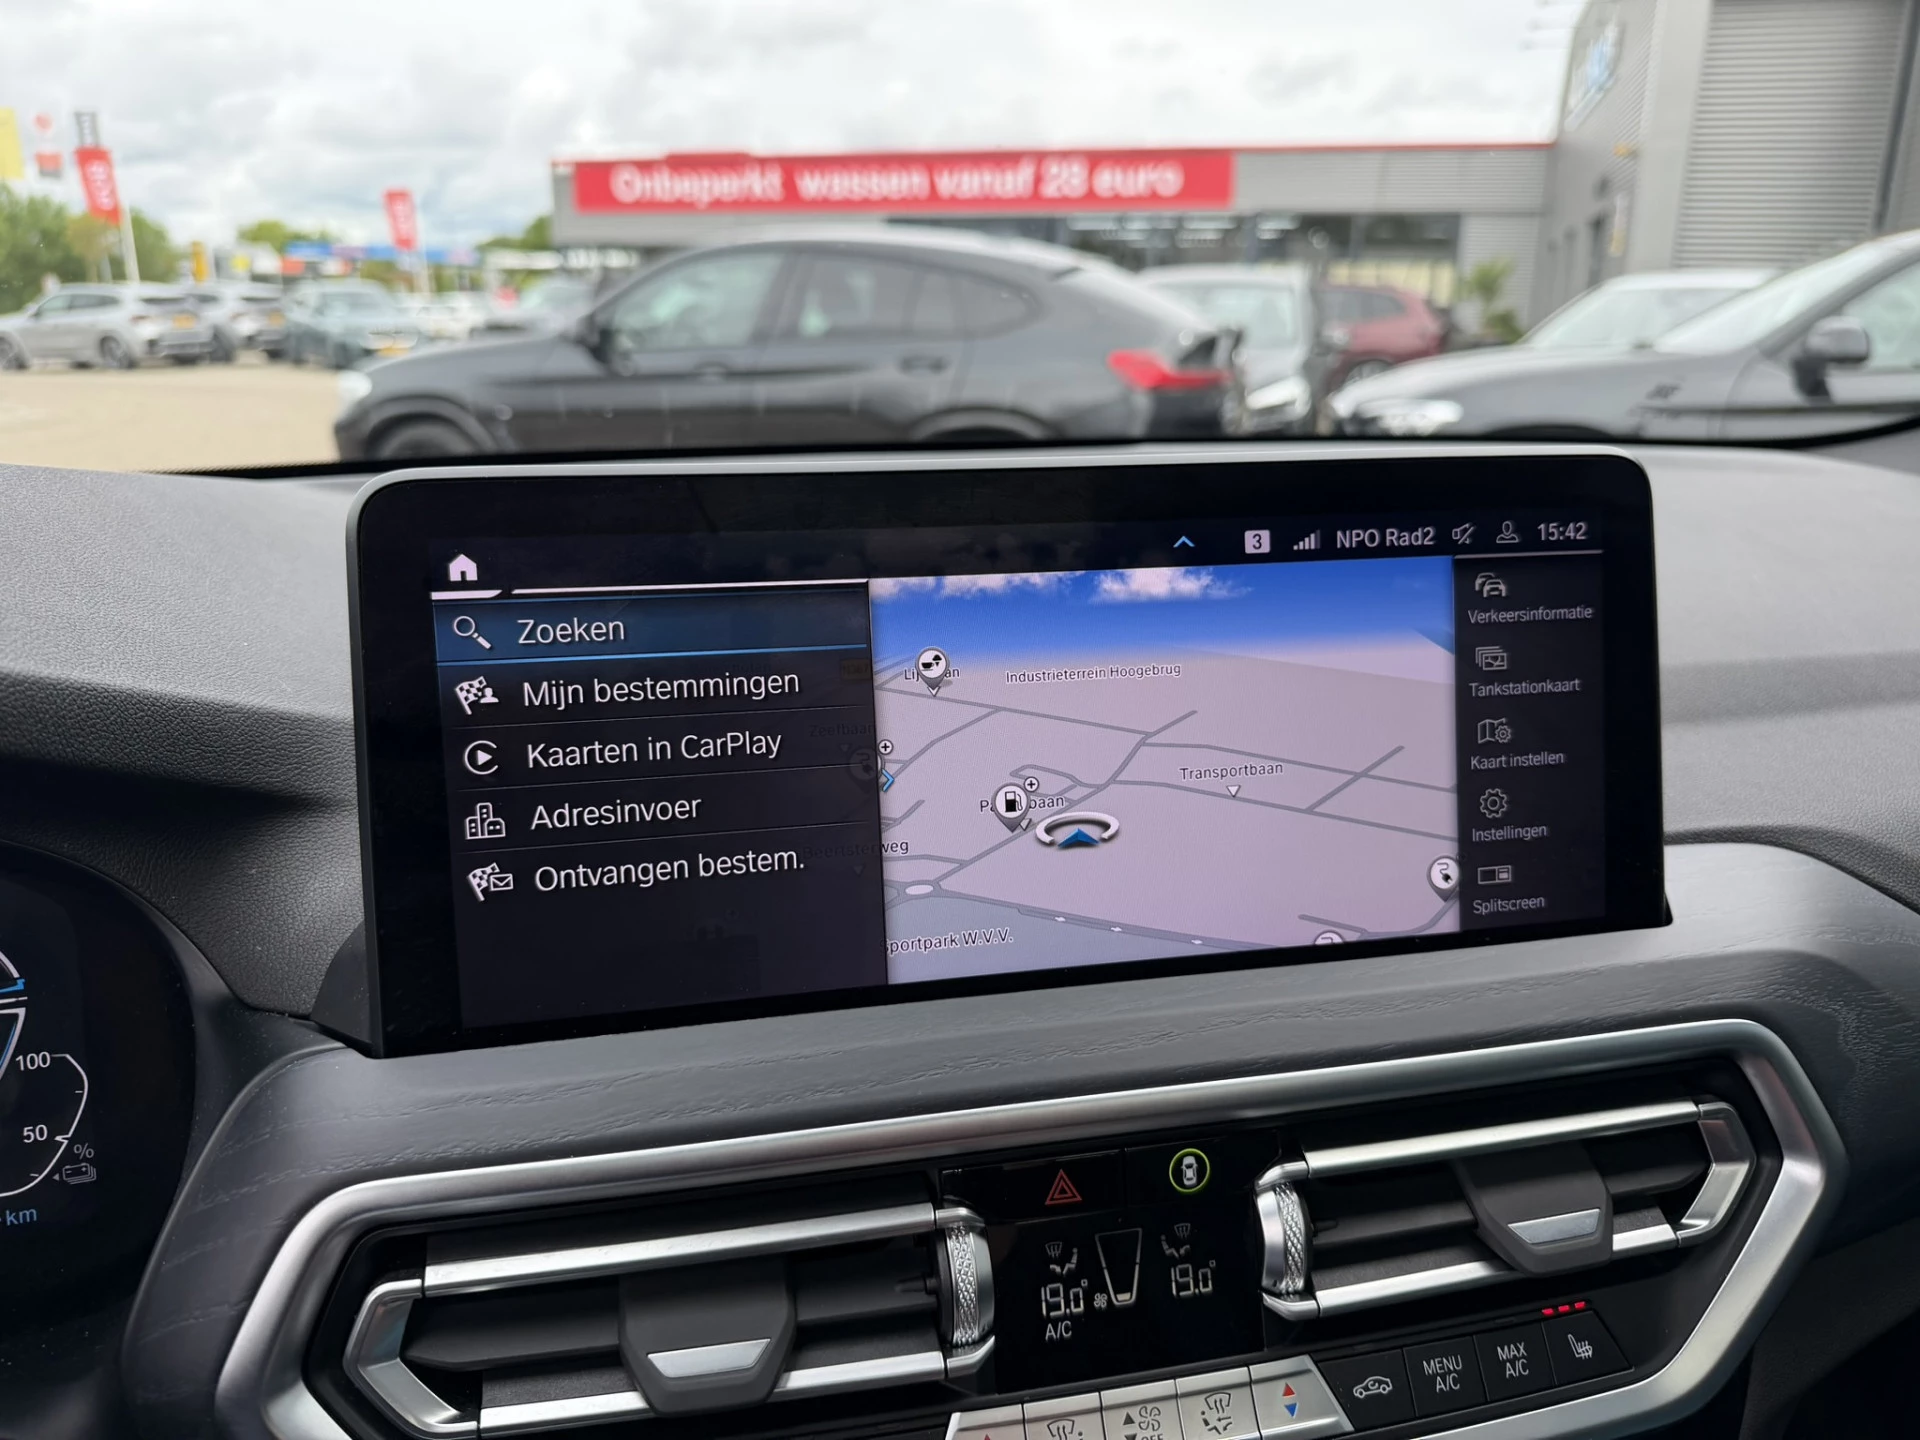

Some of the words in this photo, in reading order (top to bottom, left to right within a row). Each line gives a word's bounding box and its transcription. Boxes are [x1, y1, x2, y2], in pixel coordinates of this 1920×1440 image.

[609, 162, 783, 207] Onbeperkt
[795, 164, 928, 204] wassen
[933, 157, 1035, 199] vanaf
[1092, 160, 1183, 197] euro
[1336, 530, 1379, 548] NPO
[1385, 527, 1436, 547] Rad2
[1537, 522, 1588, 542] 15:42
[1468, 605, 1593, 624] Verkeersinformatie
[517, 617, 626, 645] Zoeken
[1005, 668, 1108, 683] Industrieterrein
[1109, 664, 1182, 680] Hoogebrug
[523, 681, 584, 710] Mijn
[594, 672, 800, 706] bestemmingen
[1469, 678, 1580, 697] Tankstationkaart
[527, 740, 638, 769] Kaarten
[648, 737, 671, 760] in
[680, 730, 782, 760] CarPlay
[1471, 755, 1508, 770] Kaart
[1509, 751, 1565, 768] instellen
[1179, 762, 1284, 780] Transportbaan
[531, 796, 702, 831] Adresinvoer
[1472, 825, 1548, 843] Instellingen
[534, 858, 689, 892] Ontvangen
[698, 849, 806, 877] bestem.
[1473, 897, 1546, 915] Splitscreen
[961, 930, 1014, 946] W.V.V.
[15, 1051, 51, 1071] 100
[23, 1124, 48, 1144] 50
[6, 1208, 37, 1226] km
[1045, 1319, 1073, 1341] A/C
[1497, 1341, 1529, 1362] MAX
[1422, 1356, 1464, 1377] MENU
[1505, 1358, 1530, 1379] A/C
[1434, 1373, 1461, 1395] A/C
